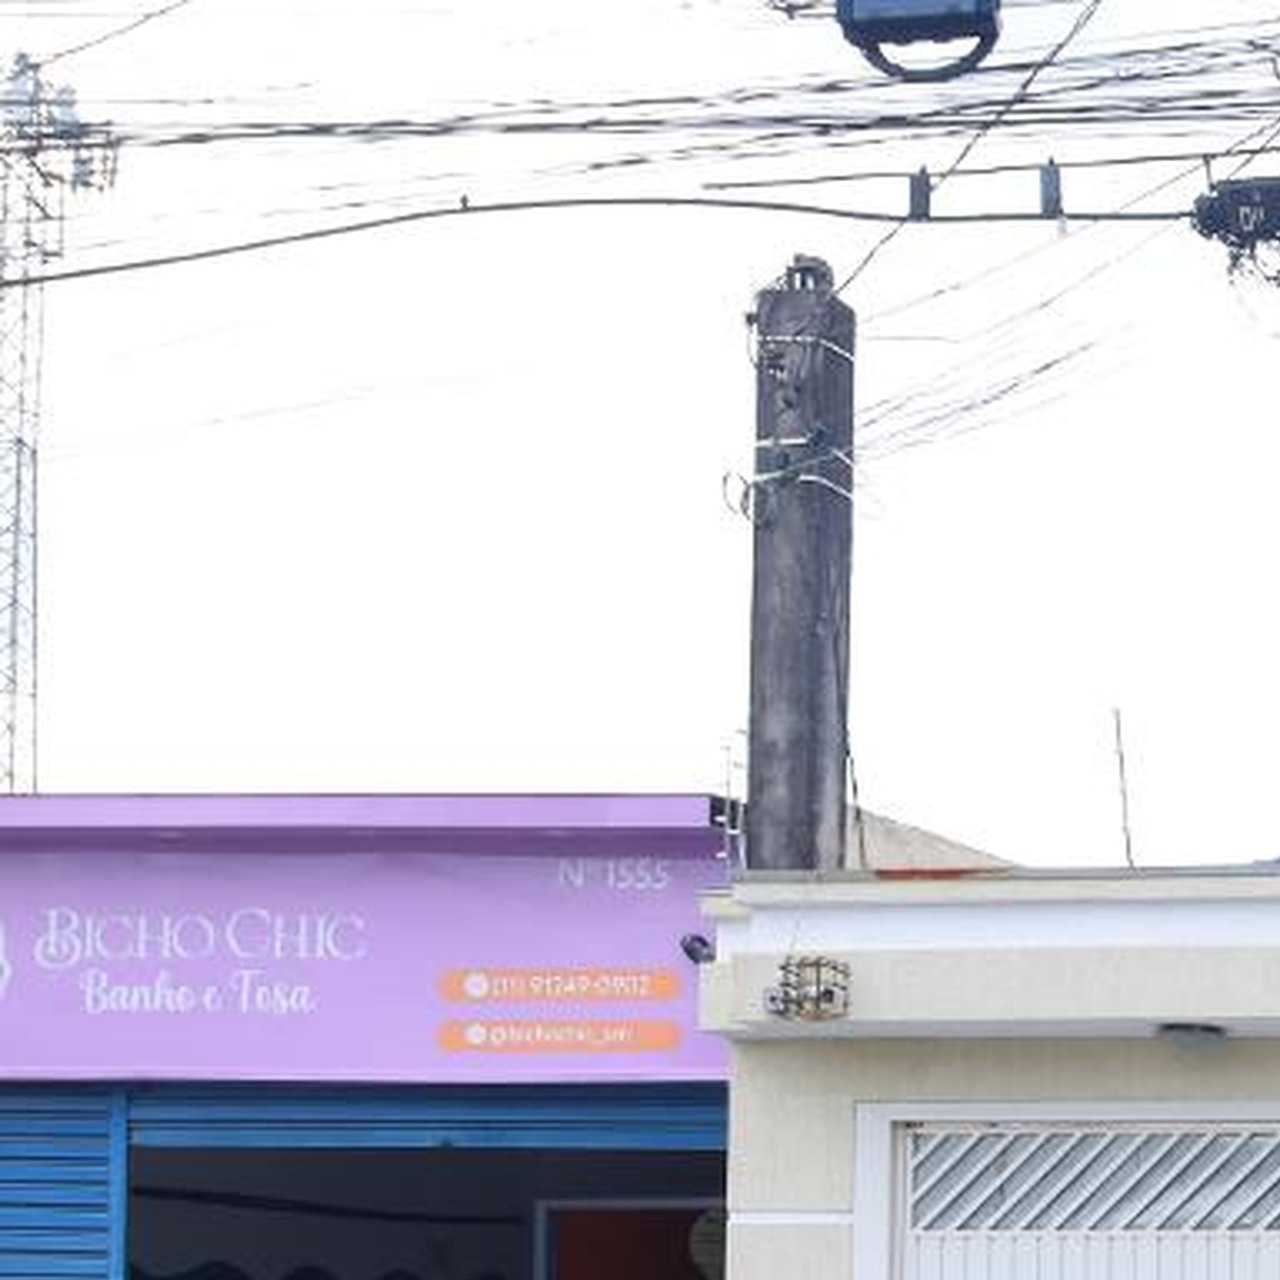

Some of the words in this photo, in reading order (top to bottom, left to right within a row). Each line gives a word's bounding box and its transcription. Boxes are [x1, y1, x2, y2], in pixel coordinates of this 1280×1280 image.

[33, 906, 216, 970] BICHO
[226, 906, 368, 960] CHIC
[79, 967, 196, 1014] Banho
[230, 967, 321, 1014] Tosa
